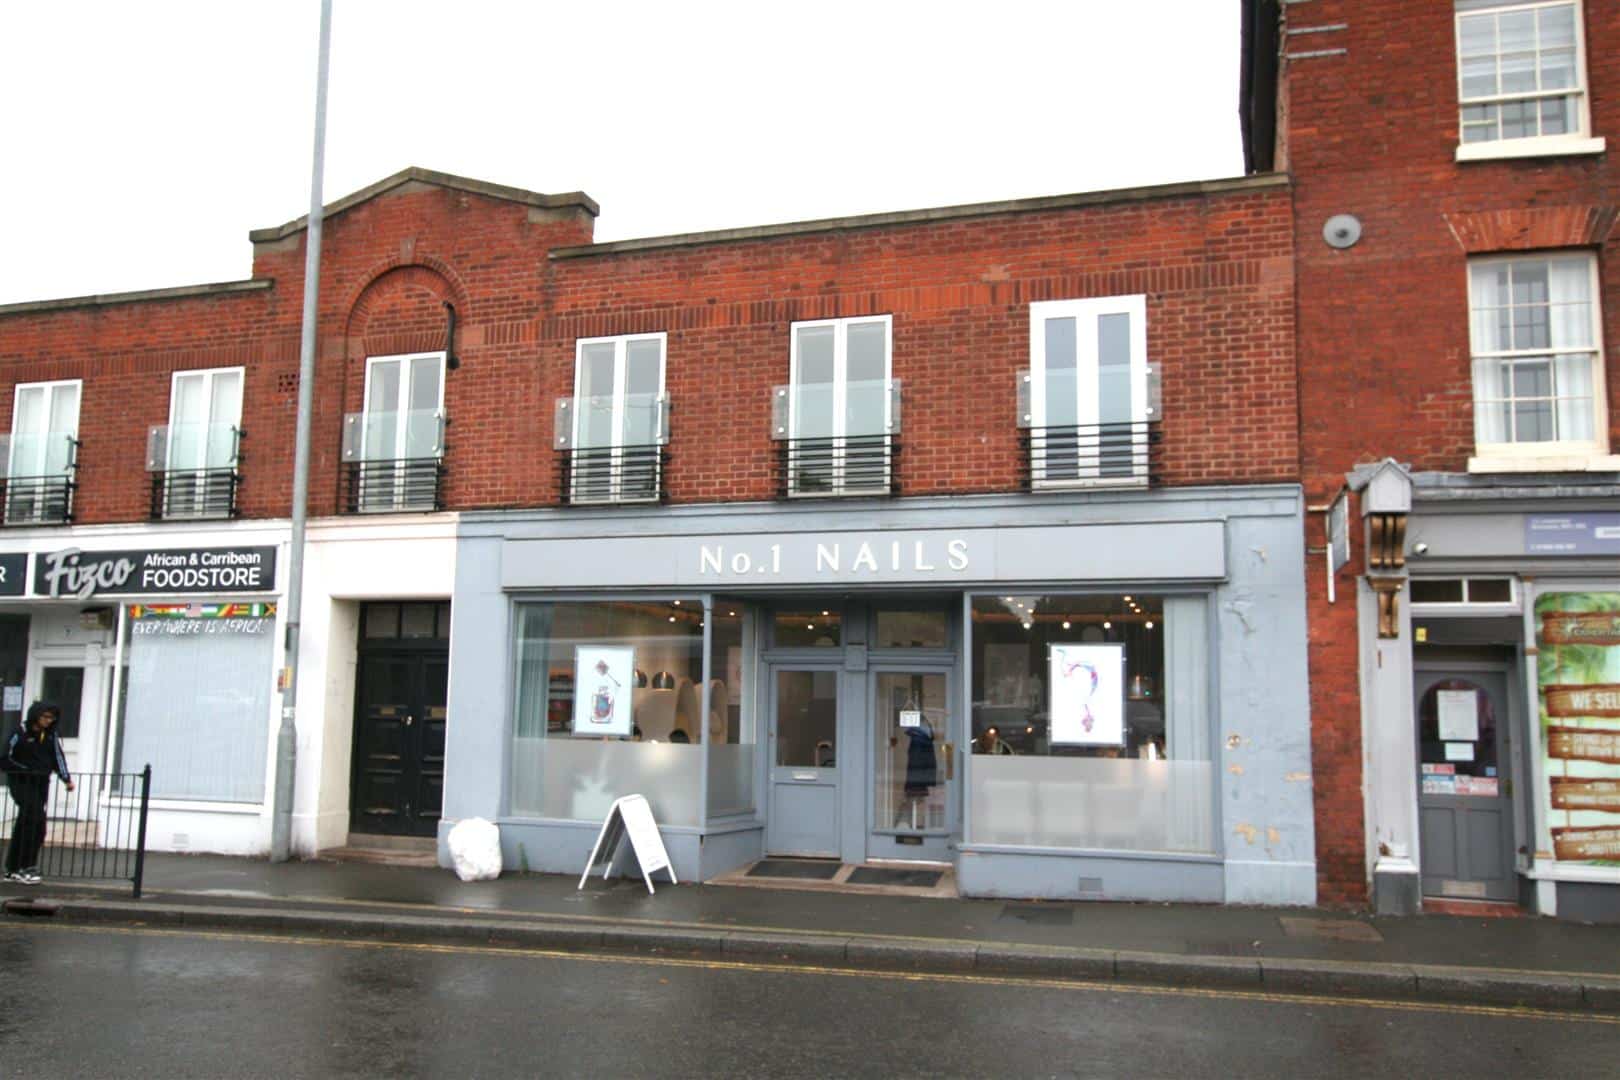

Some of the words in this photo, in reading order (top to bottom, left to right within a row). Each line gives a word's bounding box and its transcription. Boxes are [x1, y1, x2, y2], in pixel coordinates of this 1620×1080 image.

[143, 553, 186, 567] African
[188, 552, 199, 566] &
[201, 551, 261, 566] Carribean
[699, 543, 782, 574] No.1
[815, 538, 970, 572] NAILS
[44, 546, 136, 600] Fizco
[142, 567, 261, 588] FOODSTORE
